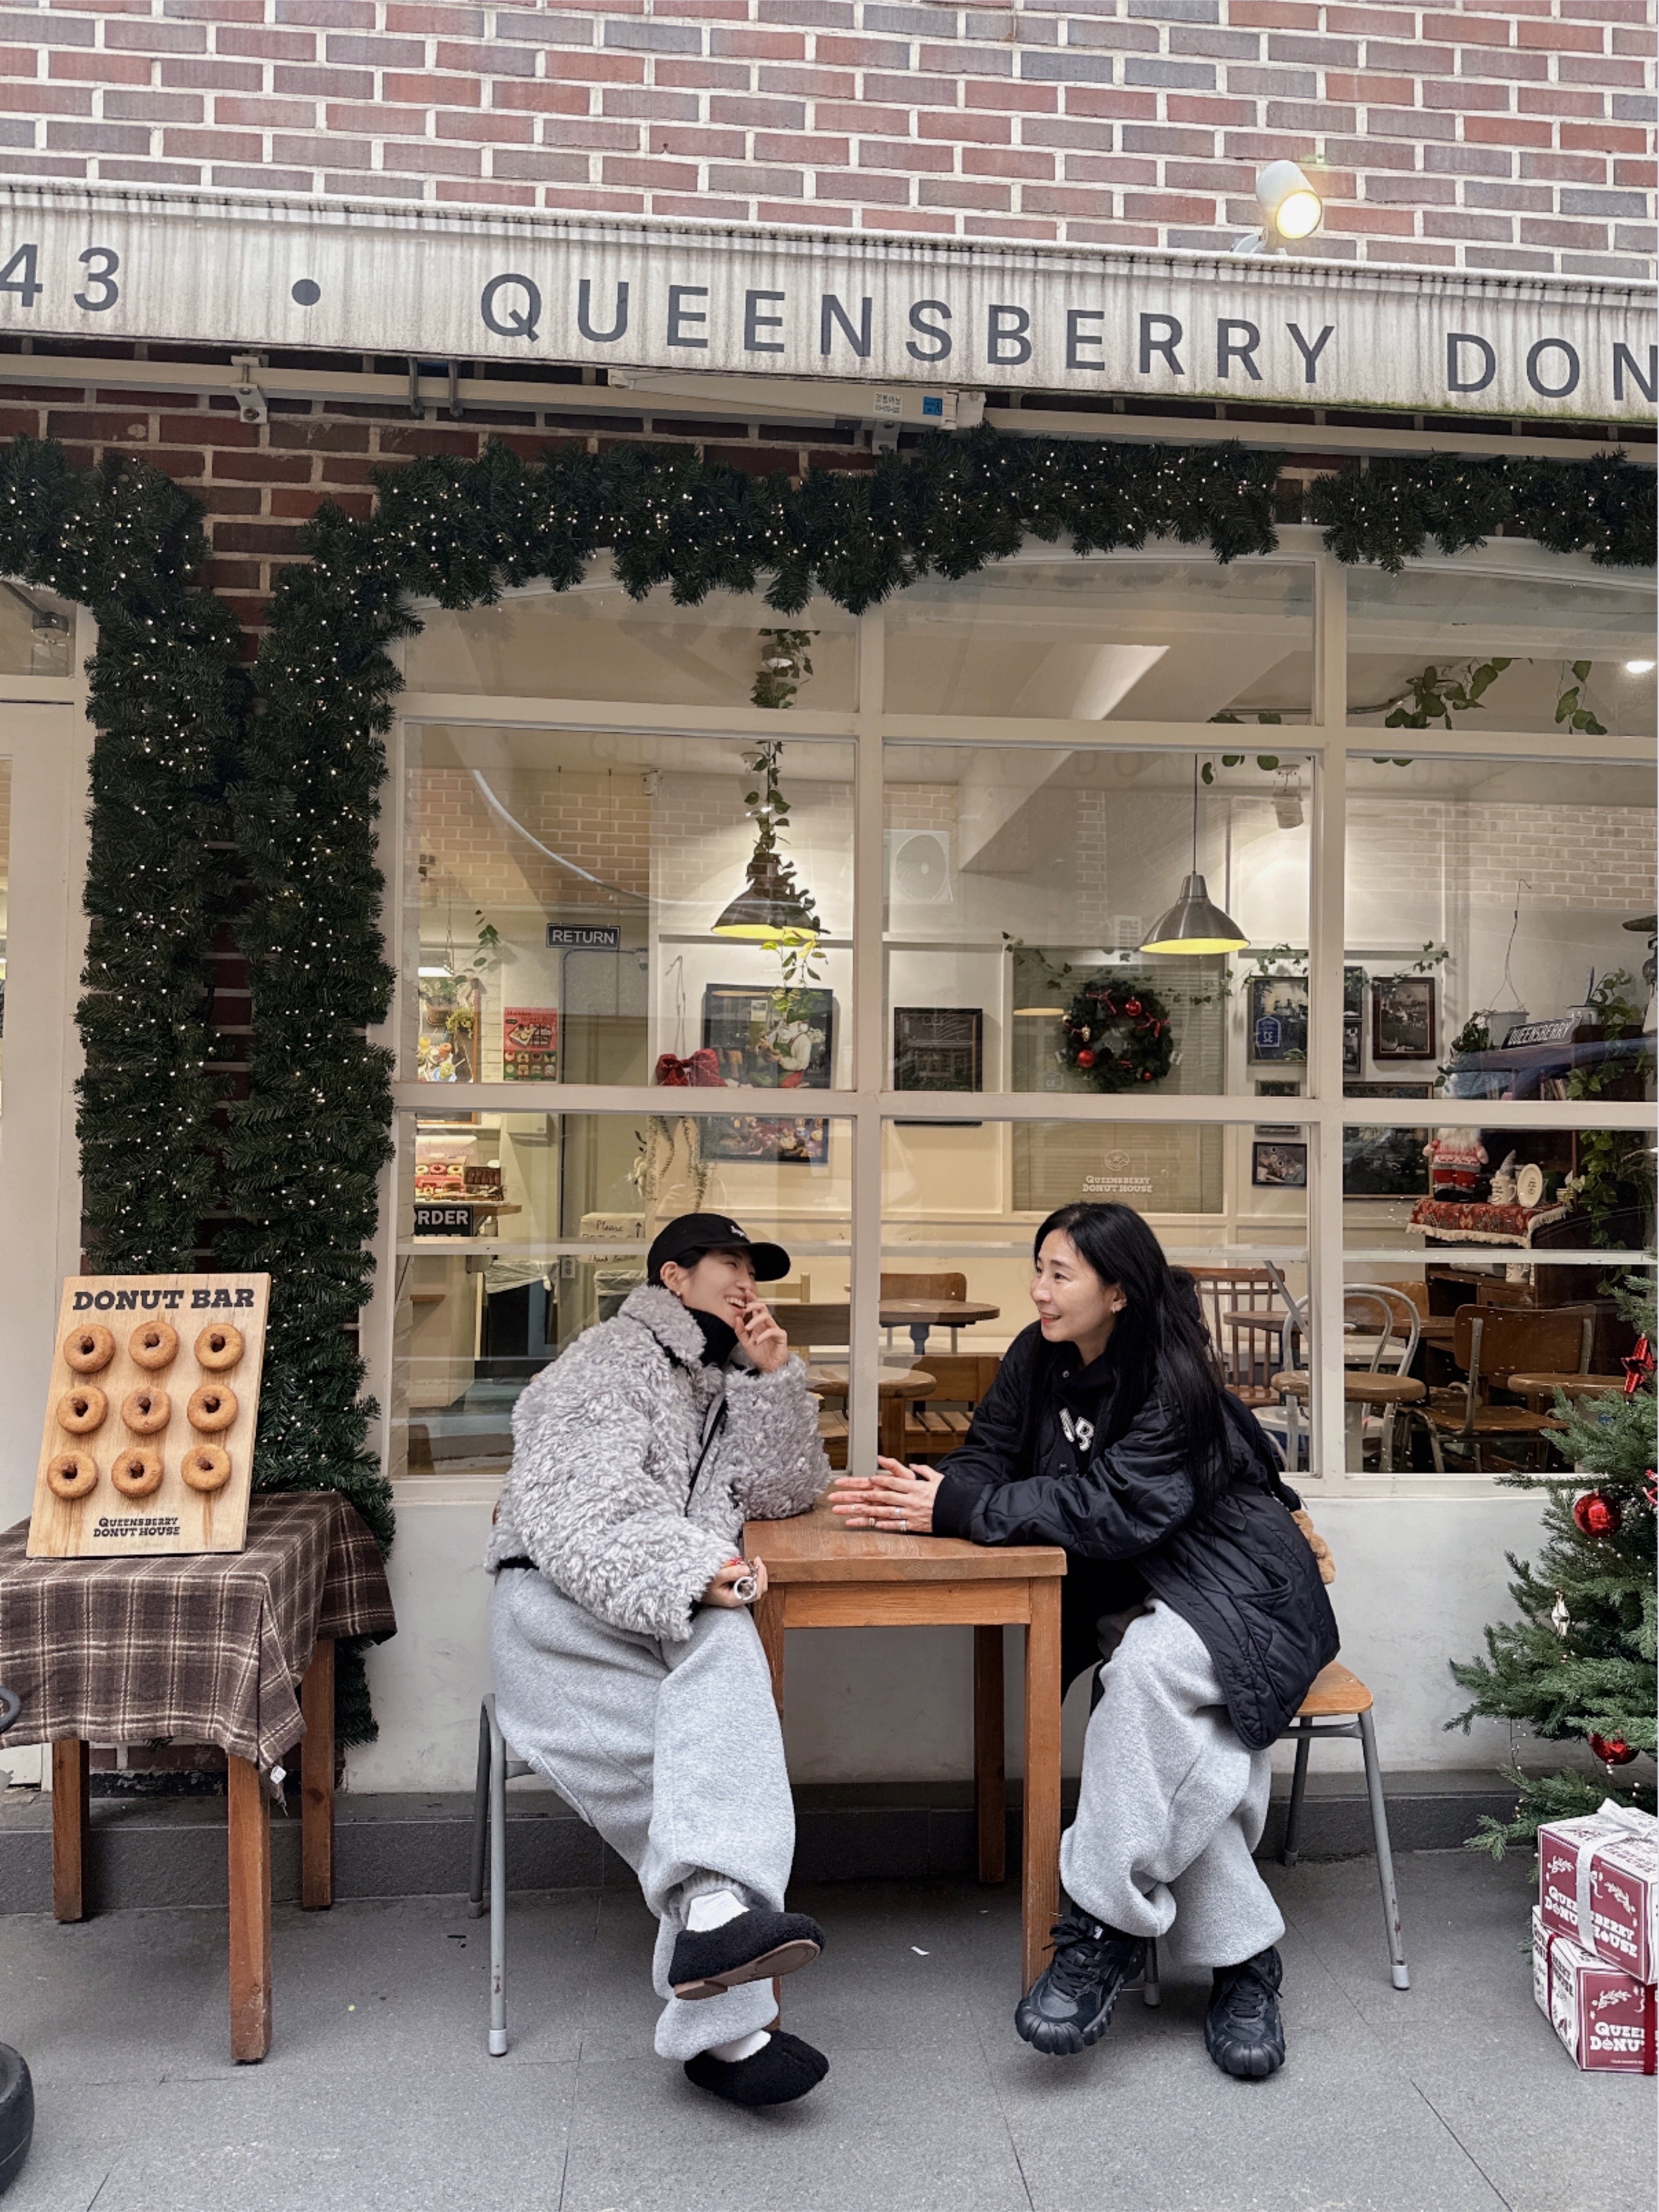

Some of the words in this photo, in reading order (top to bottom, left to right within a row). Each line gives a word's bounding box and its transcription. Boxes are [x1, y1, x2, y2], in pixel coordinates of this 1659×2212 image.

[481, 273, 1334, 383] QUEENSBERRY
[1447, 332, 1657, 401] DON
[552, 929, 614, 945] RETURN
[1508, 1022, 1572, 1045] QUEENSBERRY
[1086, 1176, 1151, 1184] QUEENSBERRY
[1082, 1184, 1118, 1192] DONUT
[414, 1210, 468, 1225] RDER
[73, 1290, 184, 1310] DONUT
[190, 1289, 255, 1308] BAR
[99, 1517, 178, 1527] QUEENSBERRY
[93, 1527, 138, 1537] DONUT
[139, 1526, 180, 1536] HOUSE
[1590, 2035, 1645, 2052] DONU
